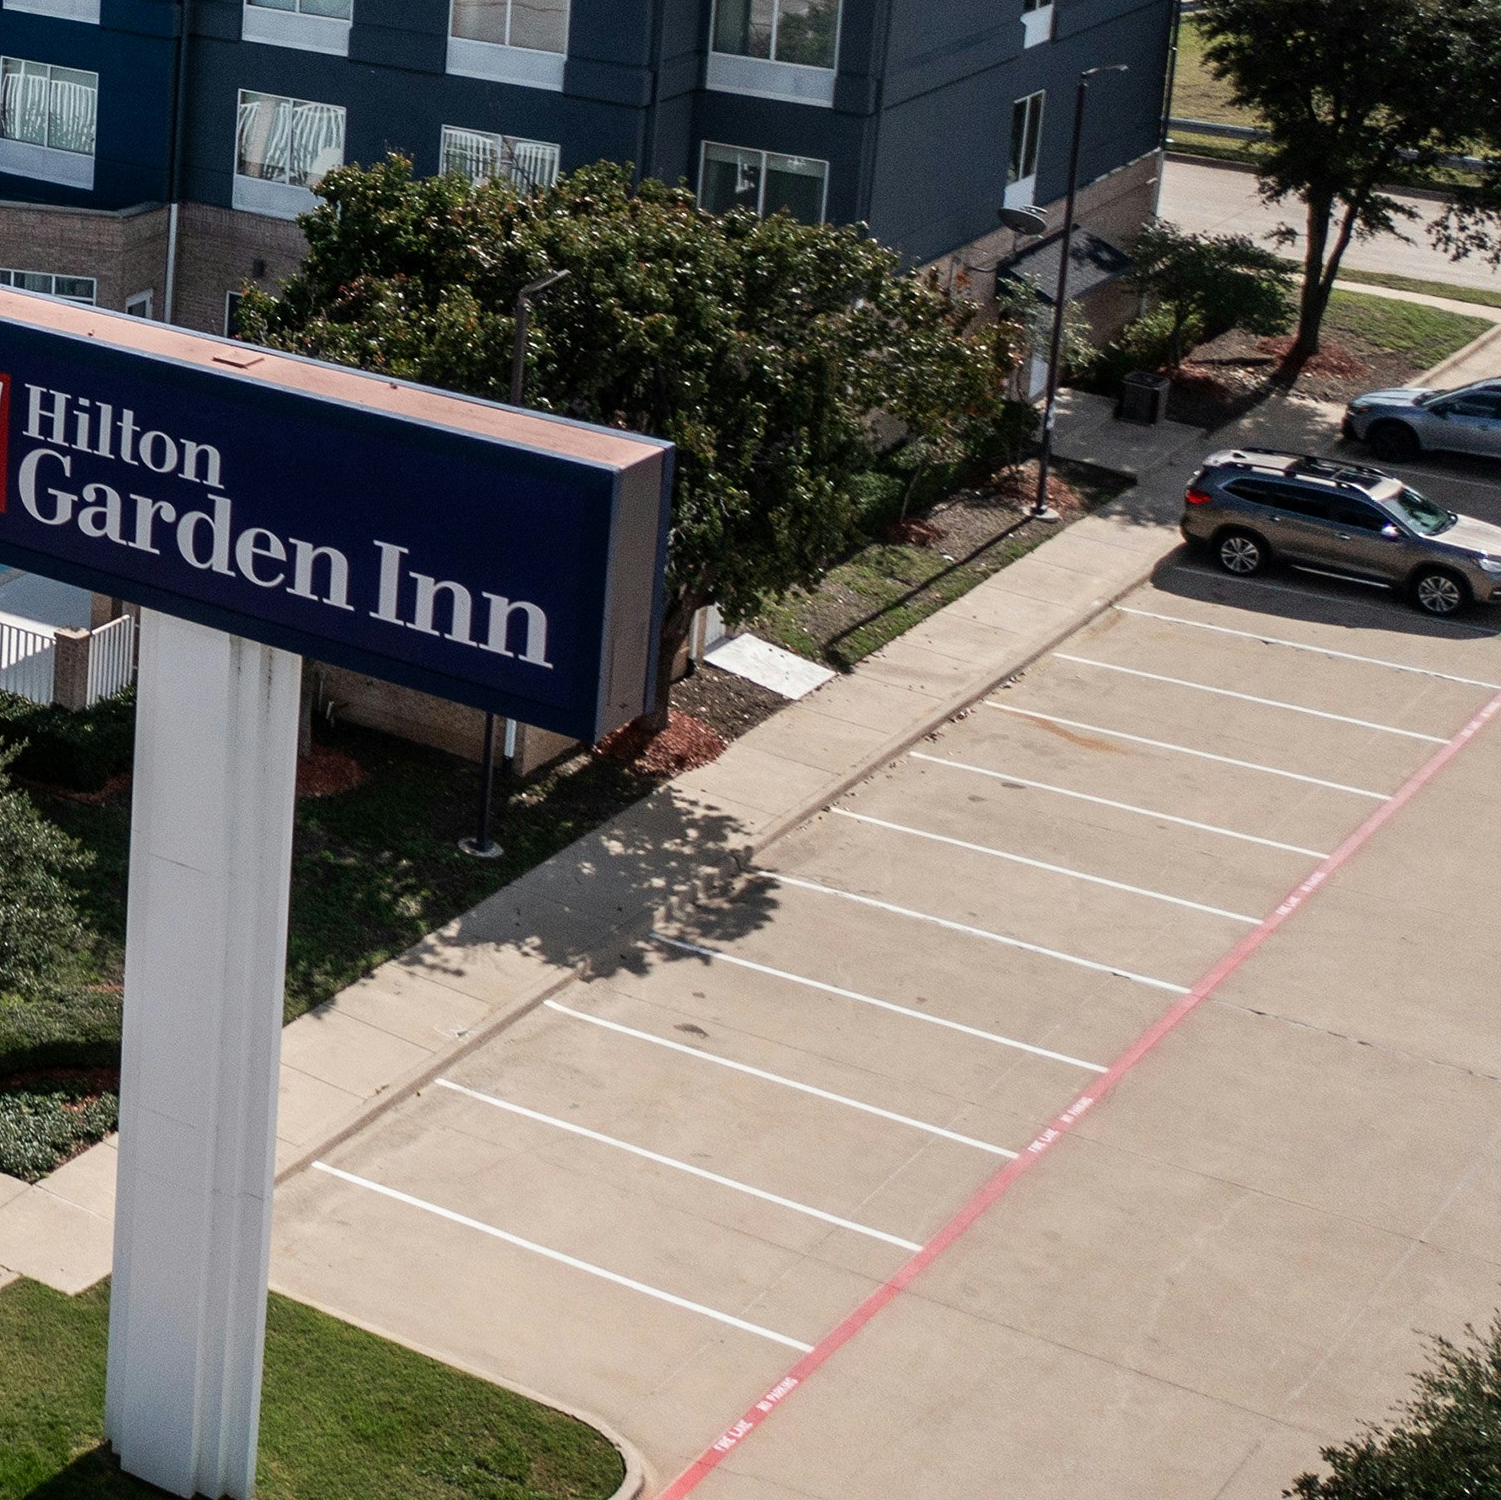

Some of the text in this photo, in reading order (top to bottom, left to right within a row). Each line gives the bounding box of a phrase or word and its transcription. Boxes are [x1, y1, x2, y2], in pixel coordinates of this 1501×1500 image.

[23, 383, 225, 489] Hilton
[18, 448, 554, 669] Garden Inn
[712, 1377, 797, 1453] FIRE LANE NO PARKING
